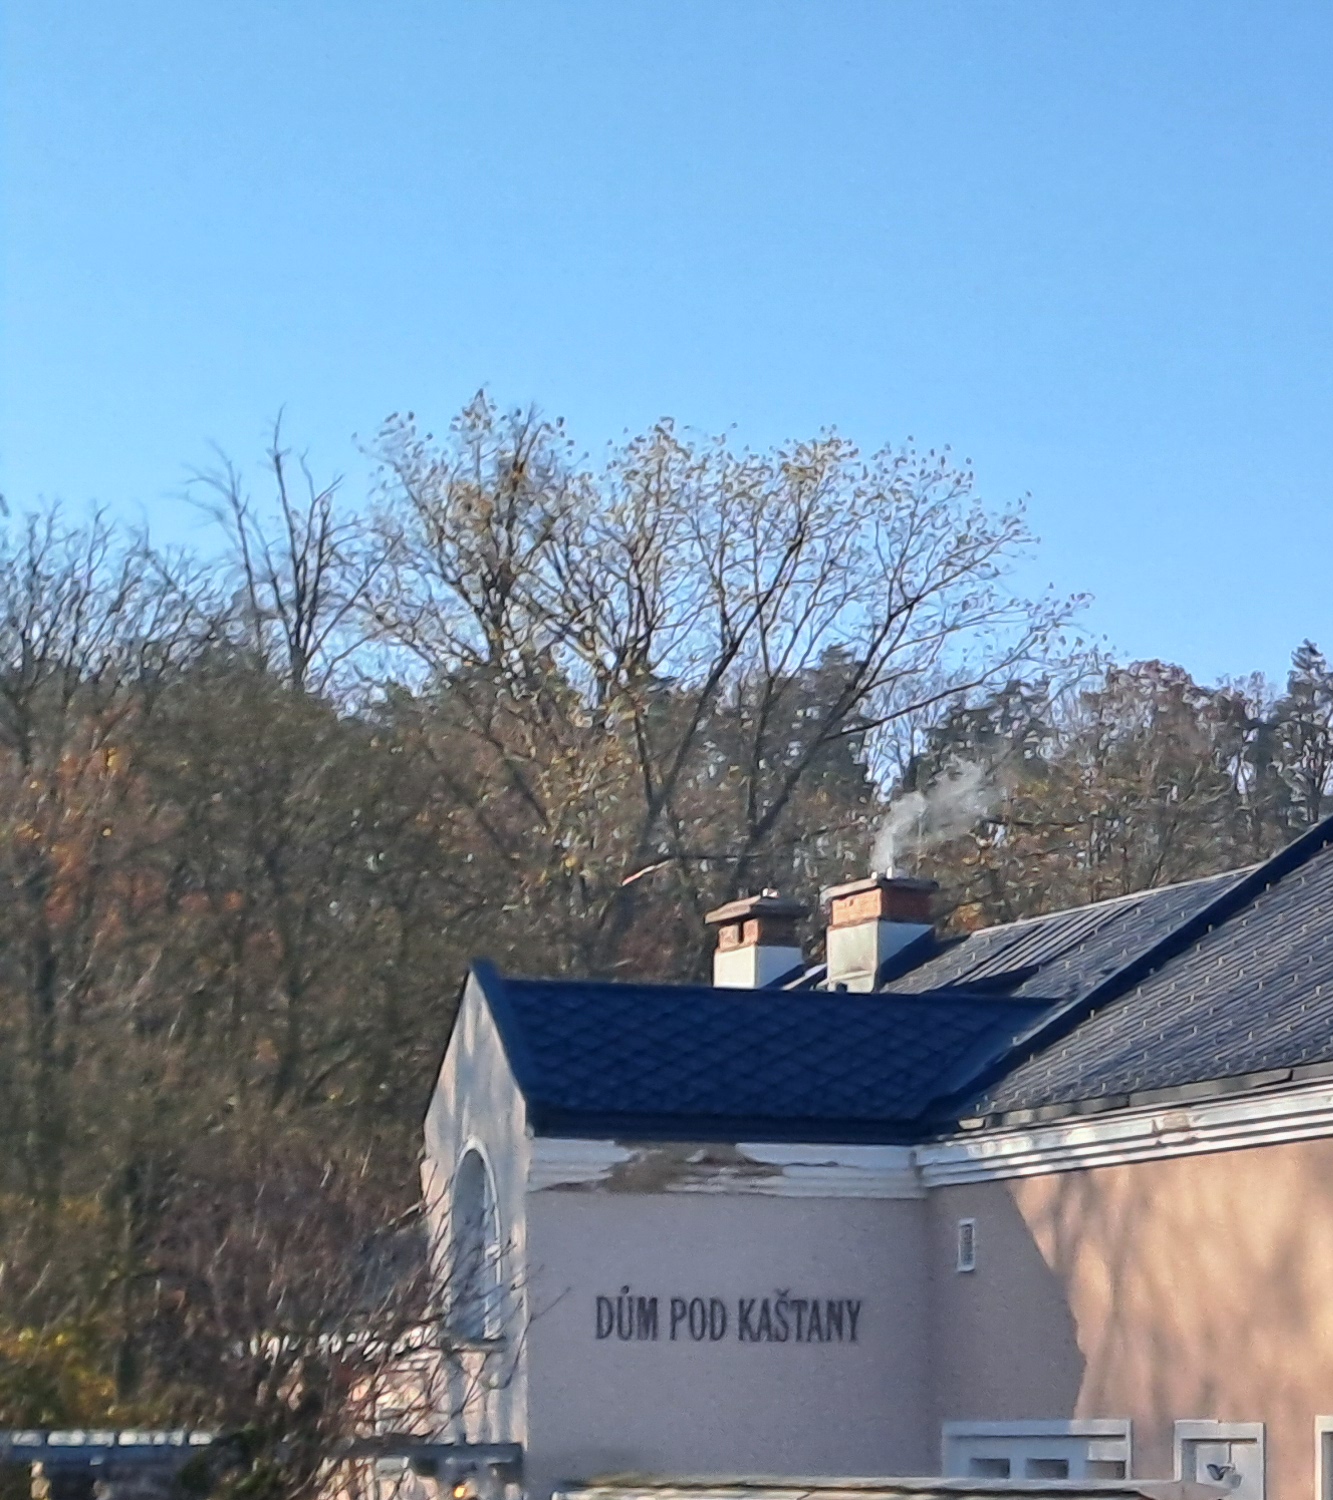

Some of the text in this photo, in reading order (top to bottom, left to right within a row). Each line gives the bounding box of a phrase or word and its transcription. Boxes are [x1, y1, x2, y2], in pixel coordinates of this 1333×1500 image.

[595, 1285, 862, 1343] DŮM POD KAŠTANY
